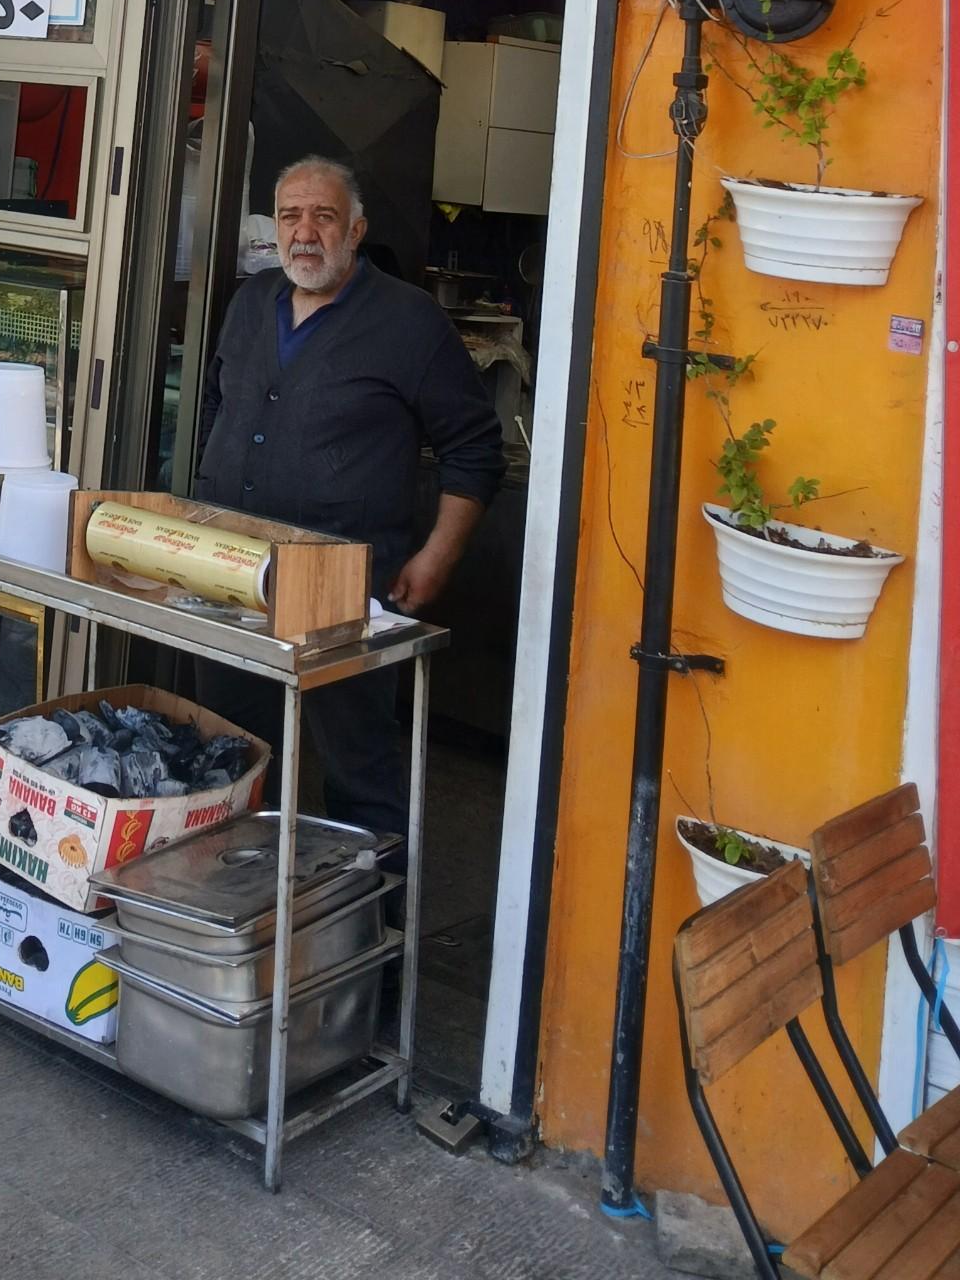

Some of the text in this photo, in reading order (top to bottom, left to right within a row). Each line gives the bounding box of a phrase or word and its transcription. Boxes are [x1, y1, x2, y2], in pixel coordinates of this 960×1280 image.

[8, 774, 56, 817] BANANA
[58, 921, 103, 947] 5H 6H 7H
